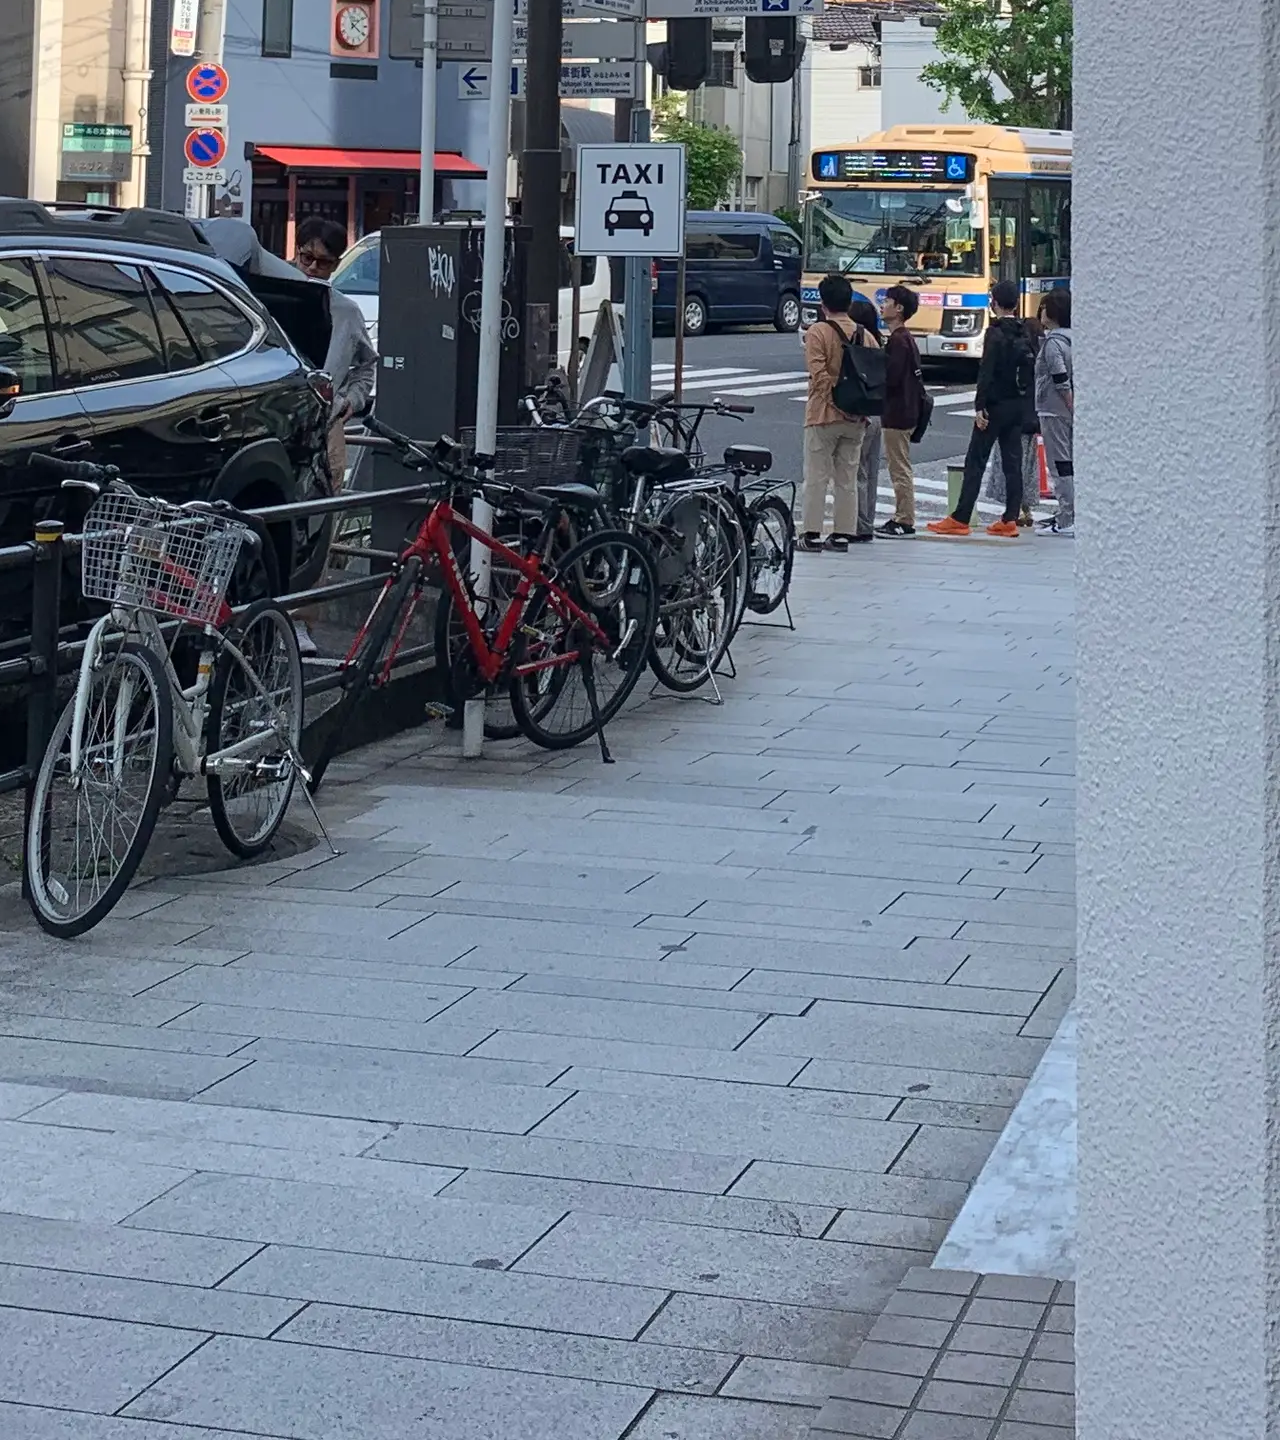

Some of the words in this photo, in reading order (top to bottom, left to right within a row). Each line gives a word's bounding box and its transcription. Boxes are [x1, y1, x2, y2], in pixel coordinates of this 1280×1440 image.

[186, 171, 223, 181] ここから
[596, 163, 664, 185] TAXI
